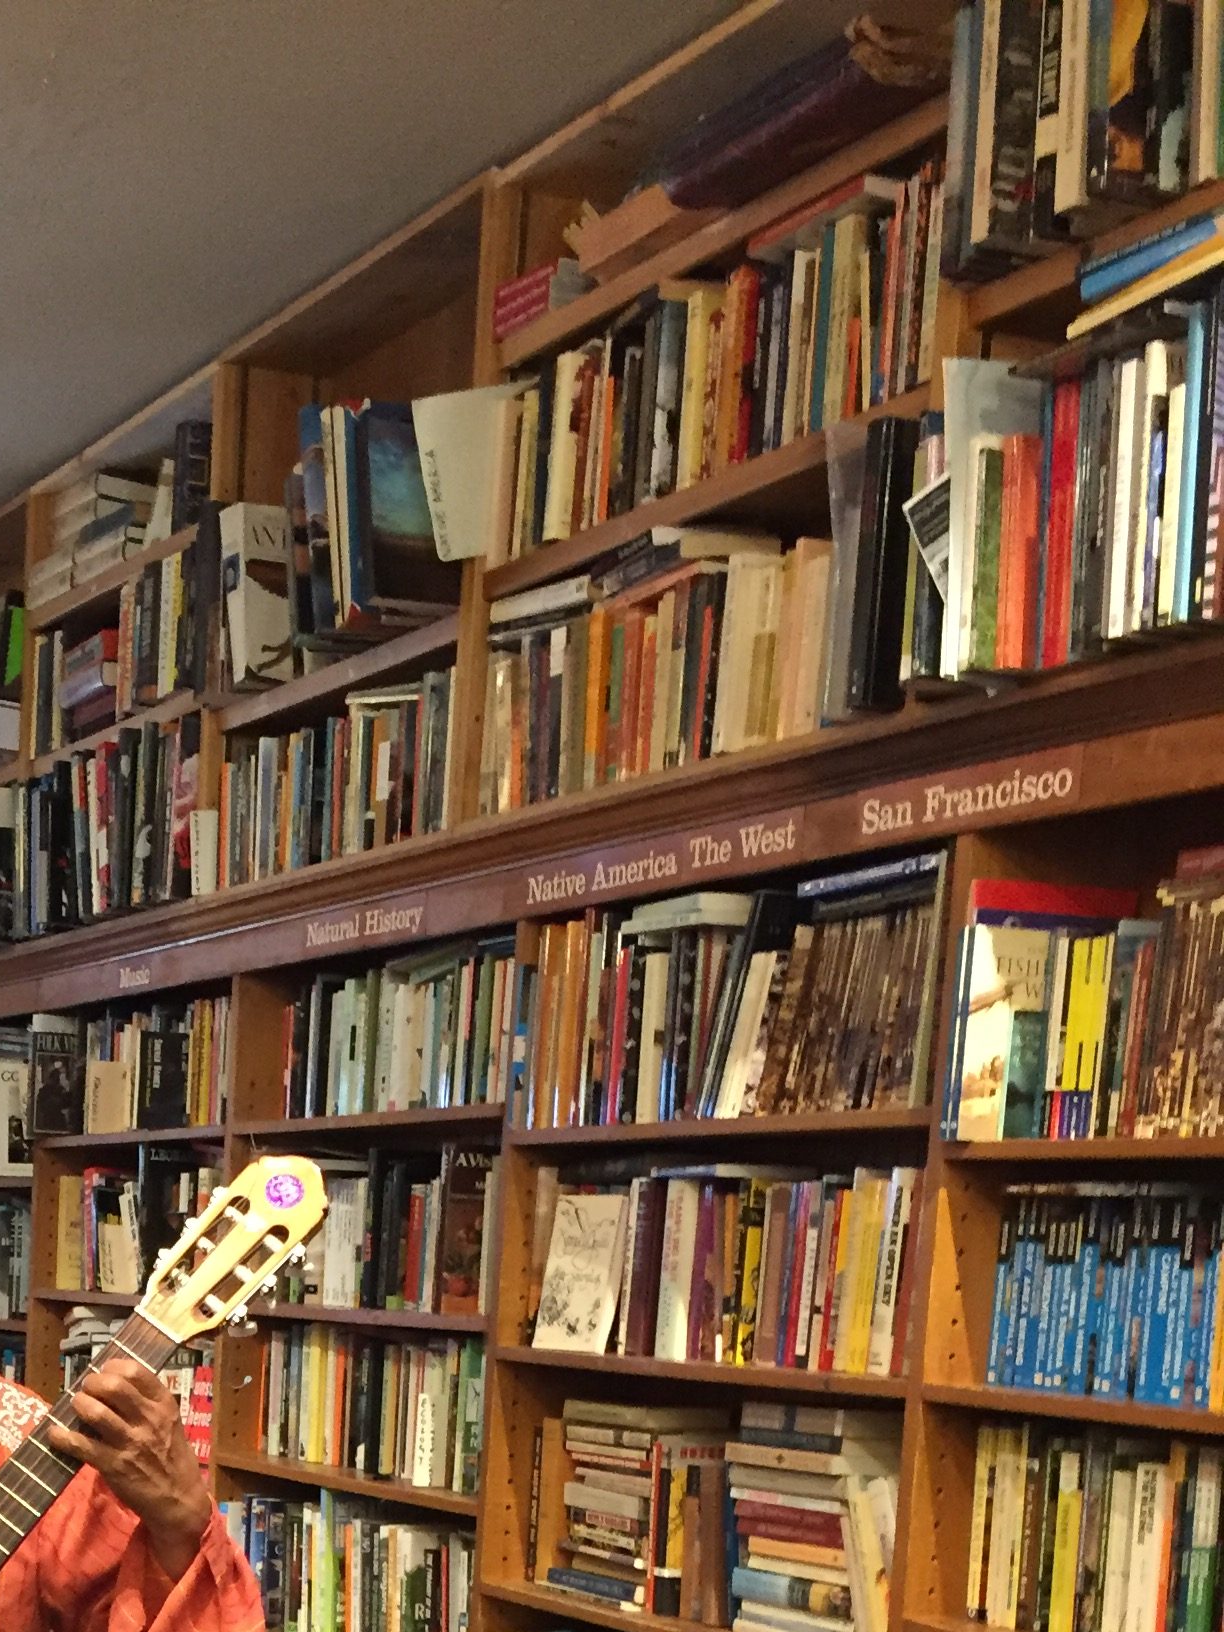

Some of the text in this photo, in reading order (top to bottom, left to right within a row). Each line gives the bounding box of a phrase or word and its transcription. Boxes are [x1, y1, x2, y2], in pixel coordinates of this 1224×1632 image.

[862, 768, 1073, 835] San Francisco
[690, 818, 797, 868] The West
[526, 850, 678, 904] Native America
[306, 906, 424, 947] Natural History
[119, 965, 151, 988] Music
